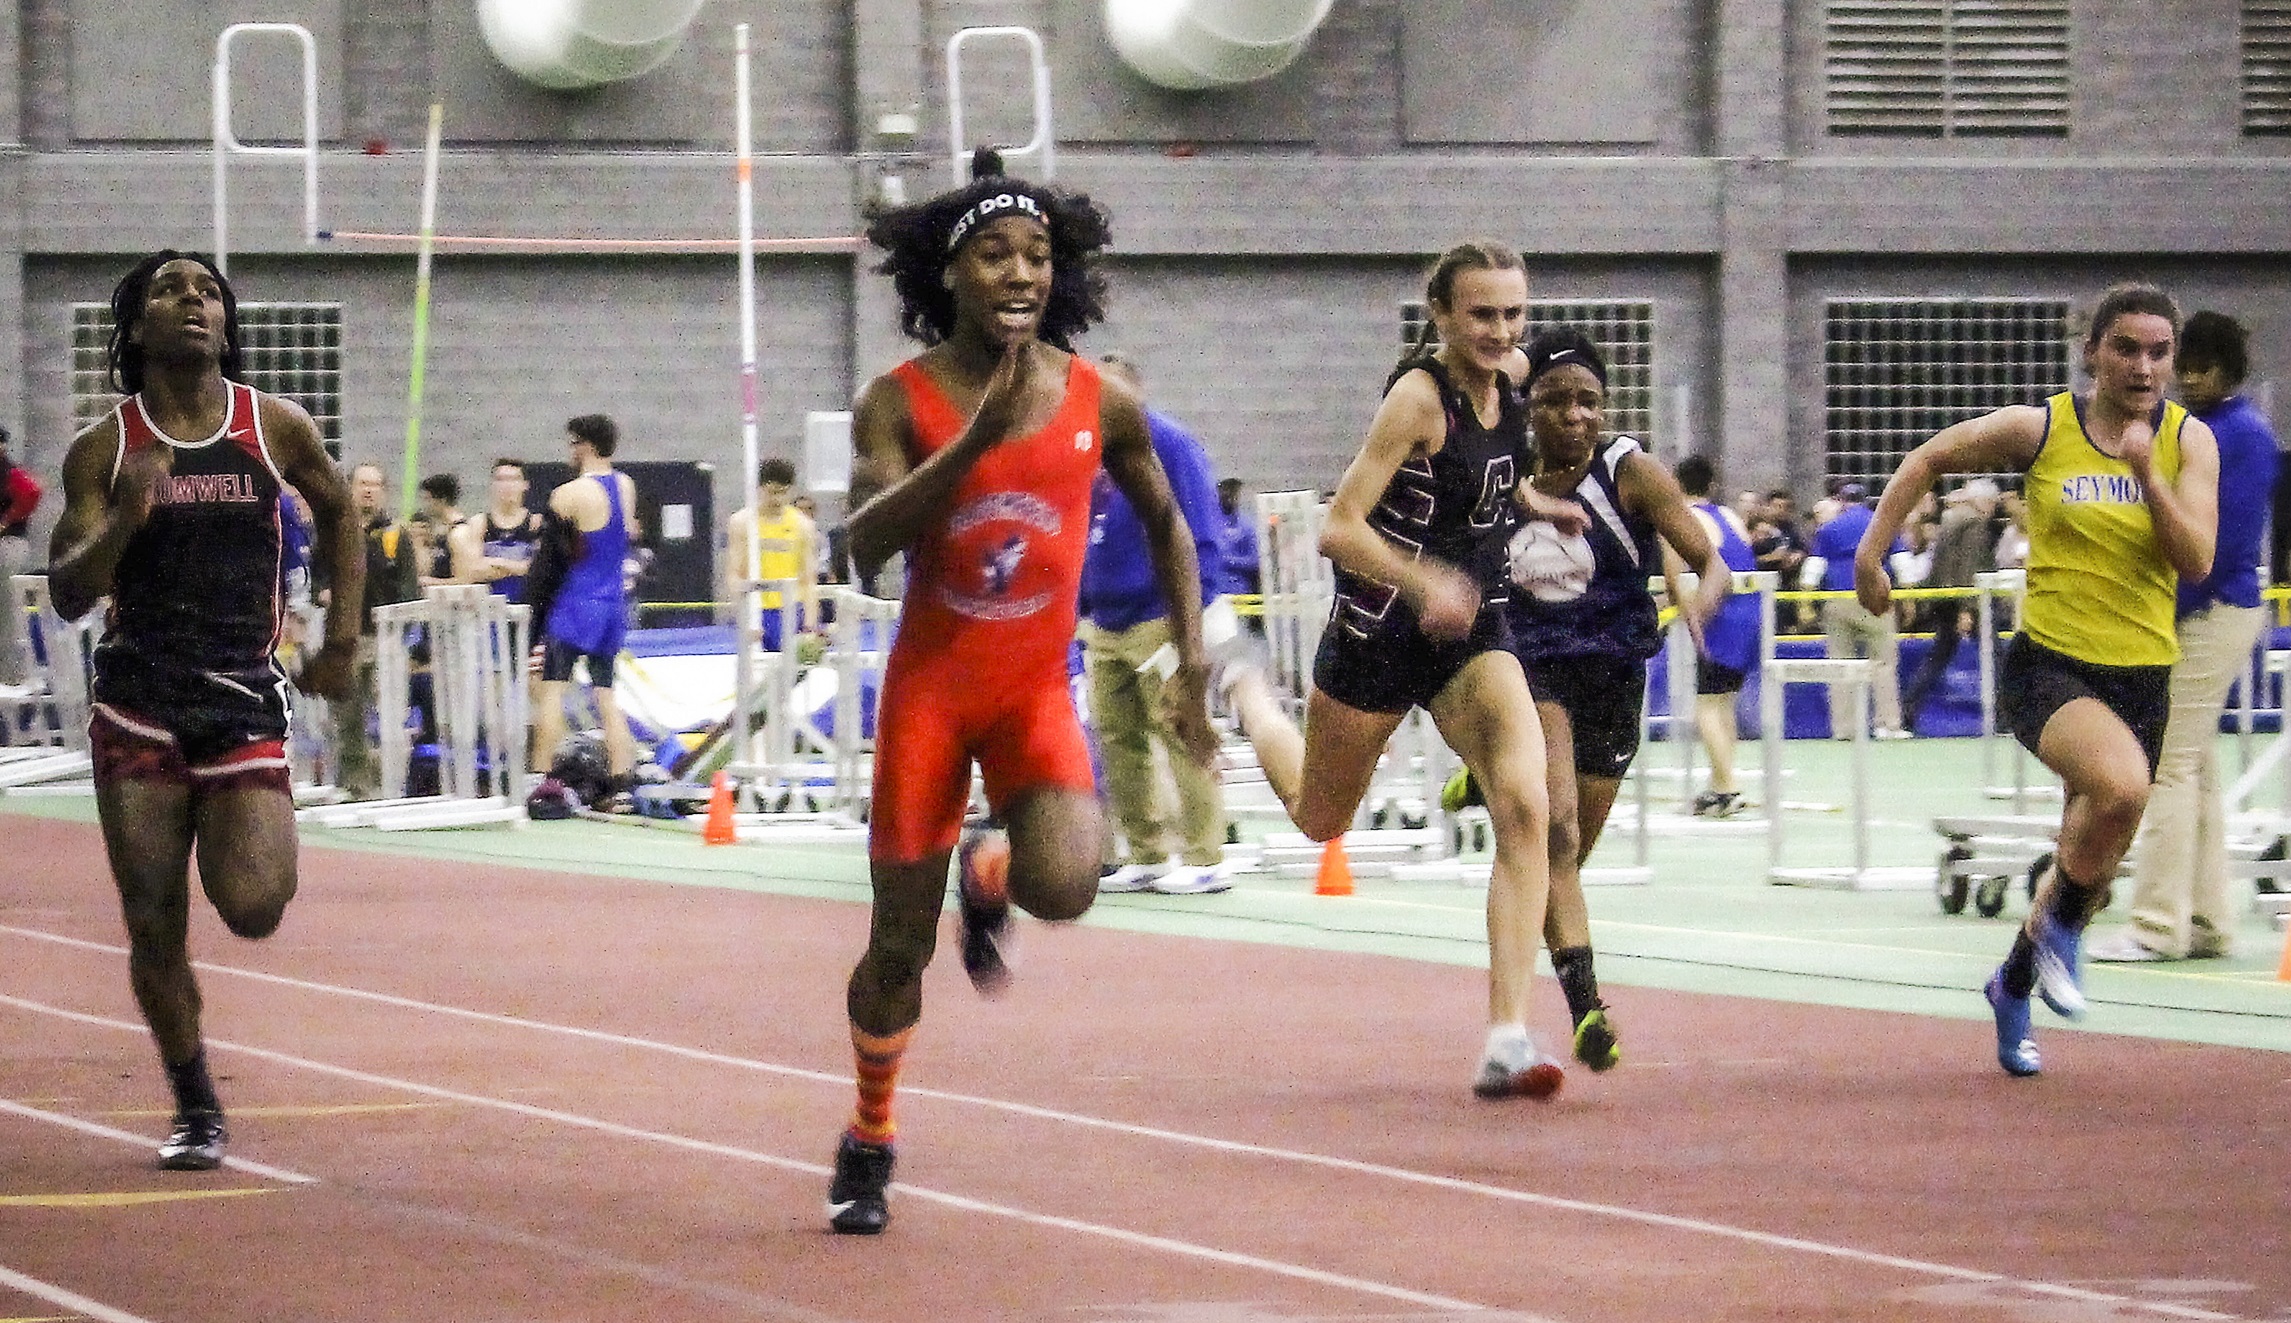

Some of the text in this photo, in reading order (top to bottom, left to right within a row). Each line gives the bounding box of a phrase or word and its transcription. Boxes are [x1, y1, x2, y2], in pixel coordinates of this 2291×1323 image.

[978, 193, 1014, 215] DO
[153, 473, 259, 503] OMWELL
[2061, 475, 2143, 504] SEYMO
